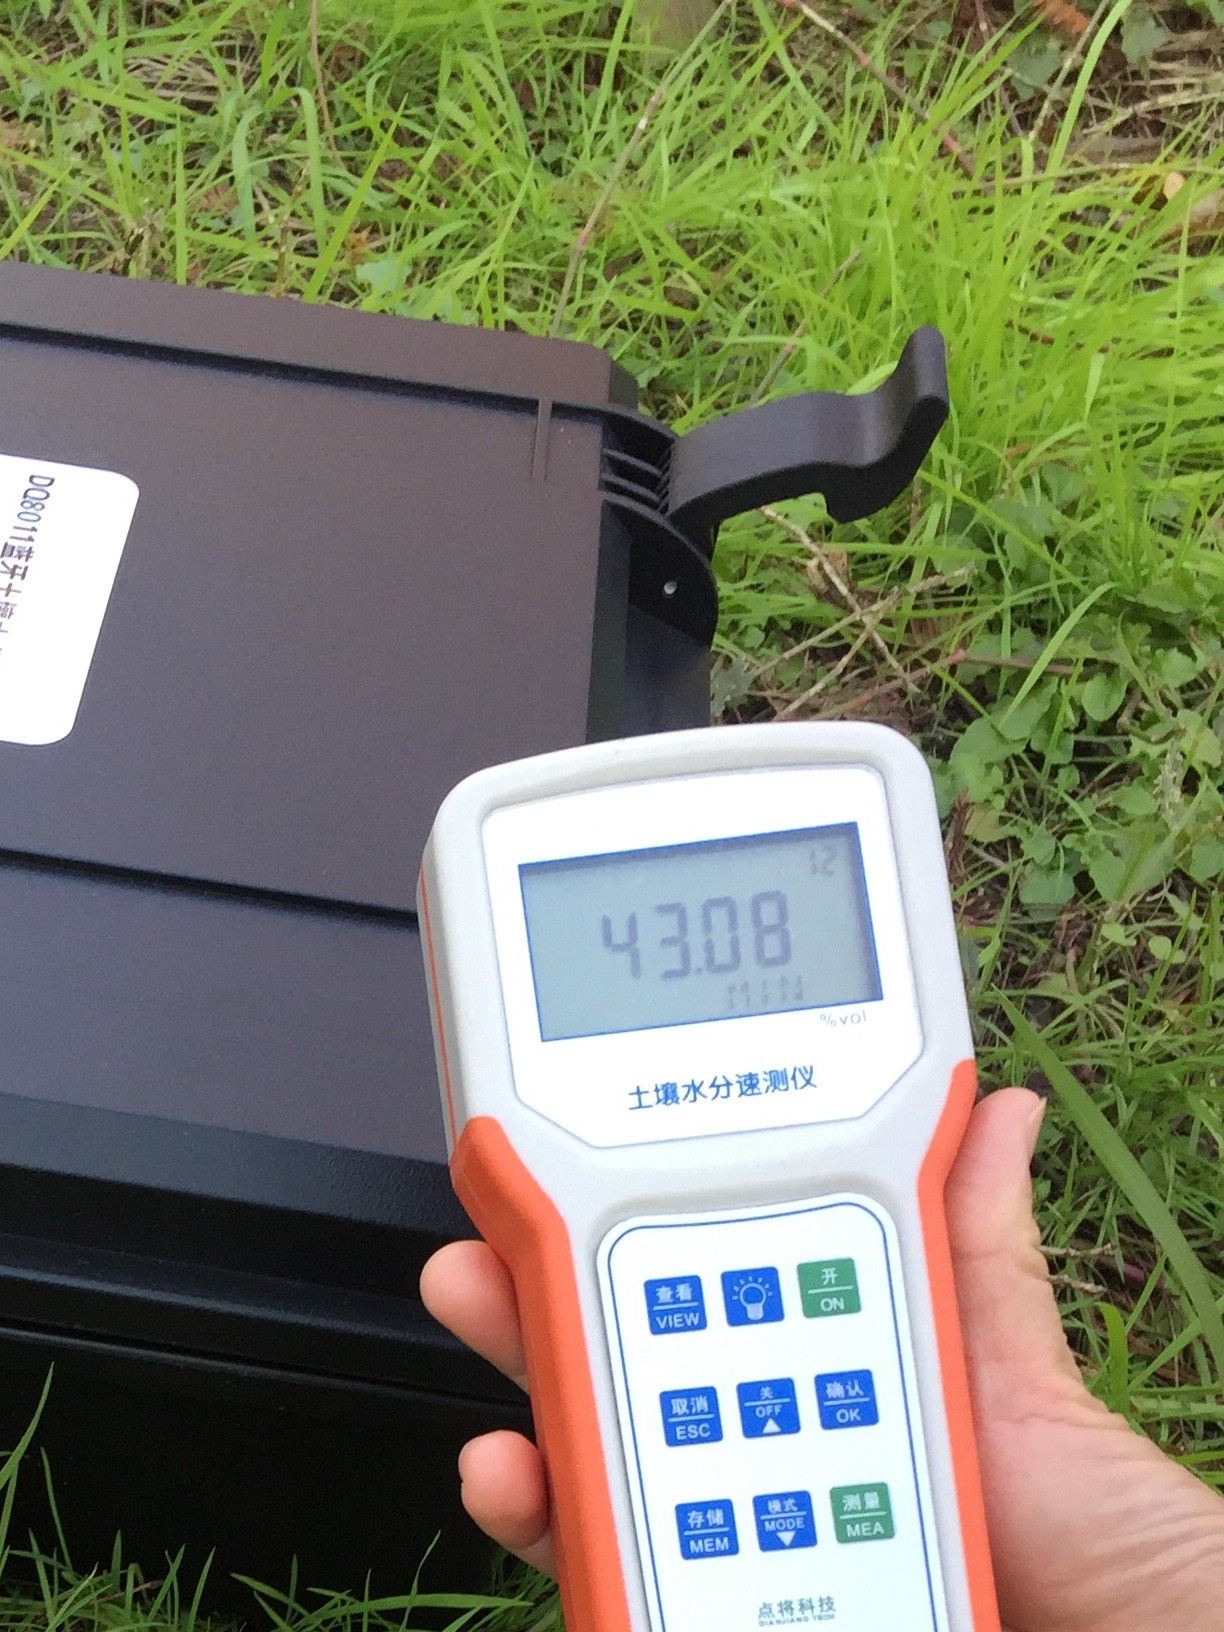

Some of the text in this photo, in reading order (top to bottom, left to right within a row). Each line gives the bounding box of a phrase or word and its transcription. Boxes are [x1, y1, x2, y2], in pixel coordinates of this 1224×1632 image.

[602, 890, 792, 981] 43.08
[628, 1065, 818, 1111] 土壤水分速测仪
[821, 1267, 838, 1285] 开
[656, 1284, 694, 1303] 查看
[820, 1297, 845, 1313] ON
[656, 1313, 700, 1329] VIEW
[760, 1386, 774, 1400] 关
[825, 1379, 864, 1398] 确认
[671, 1394, 709, 1414] 取消
[755, 1404, 782, 1418] OFF
[836, 1408, 862, 1424] OK
[675, 1423, 711, 1440] ESC
[768, 1498, 798, 1513] 模式
[842, 1491, 881, 1510] 测量
[687, 1508, 724, 1527] 存储
[764, 1517, 805, 1532] MODE
[846, 1522, 885, 1539] MEA
[689, 1537, 729, 1554] MEM
[757, 1595, 836, 1620] 点将科技
